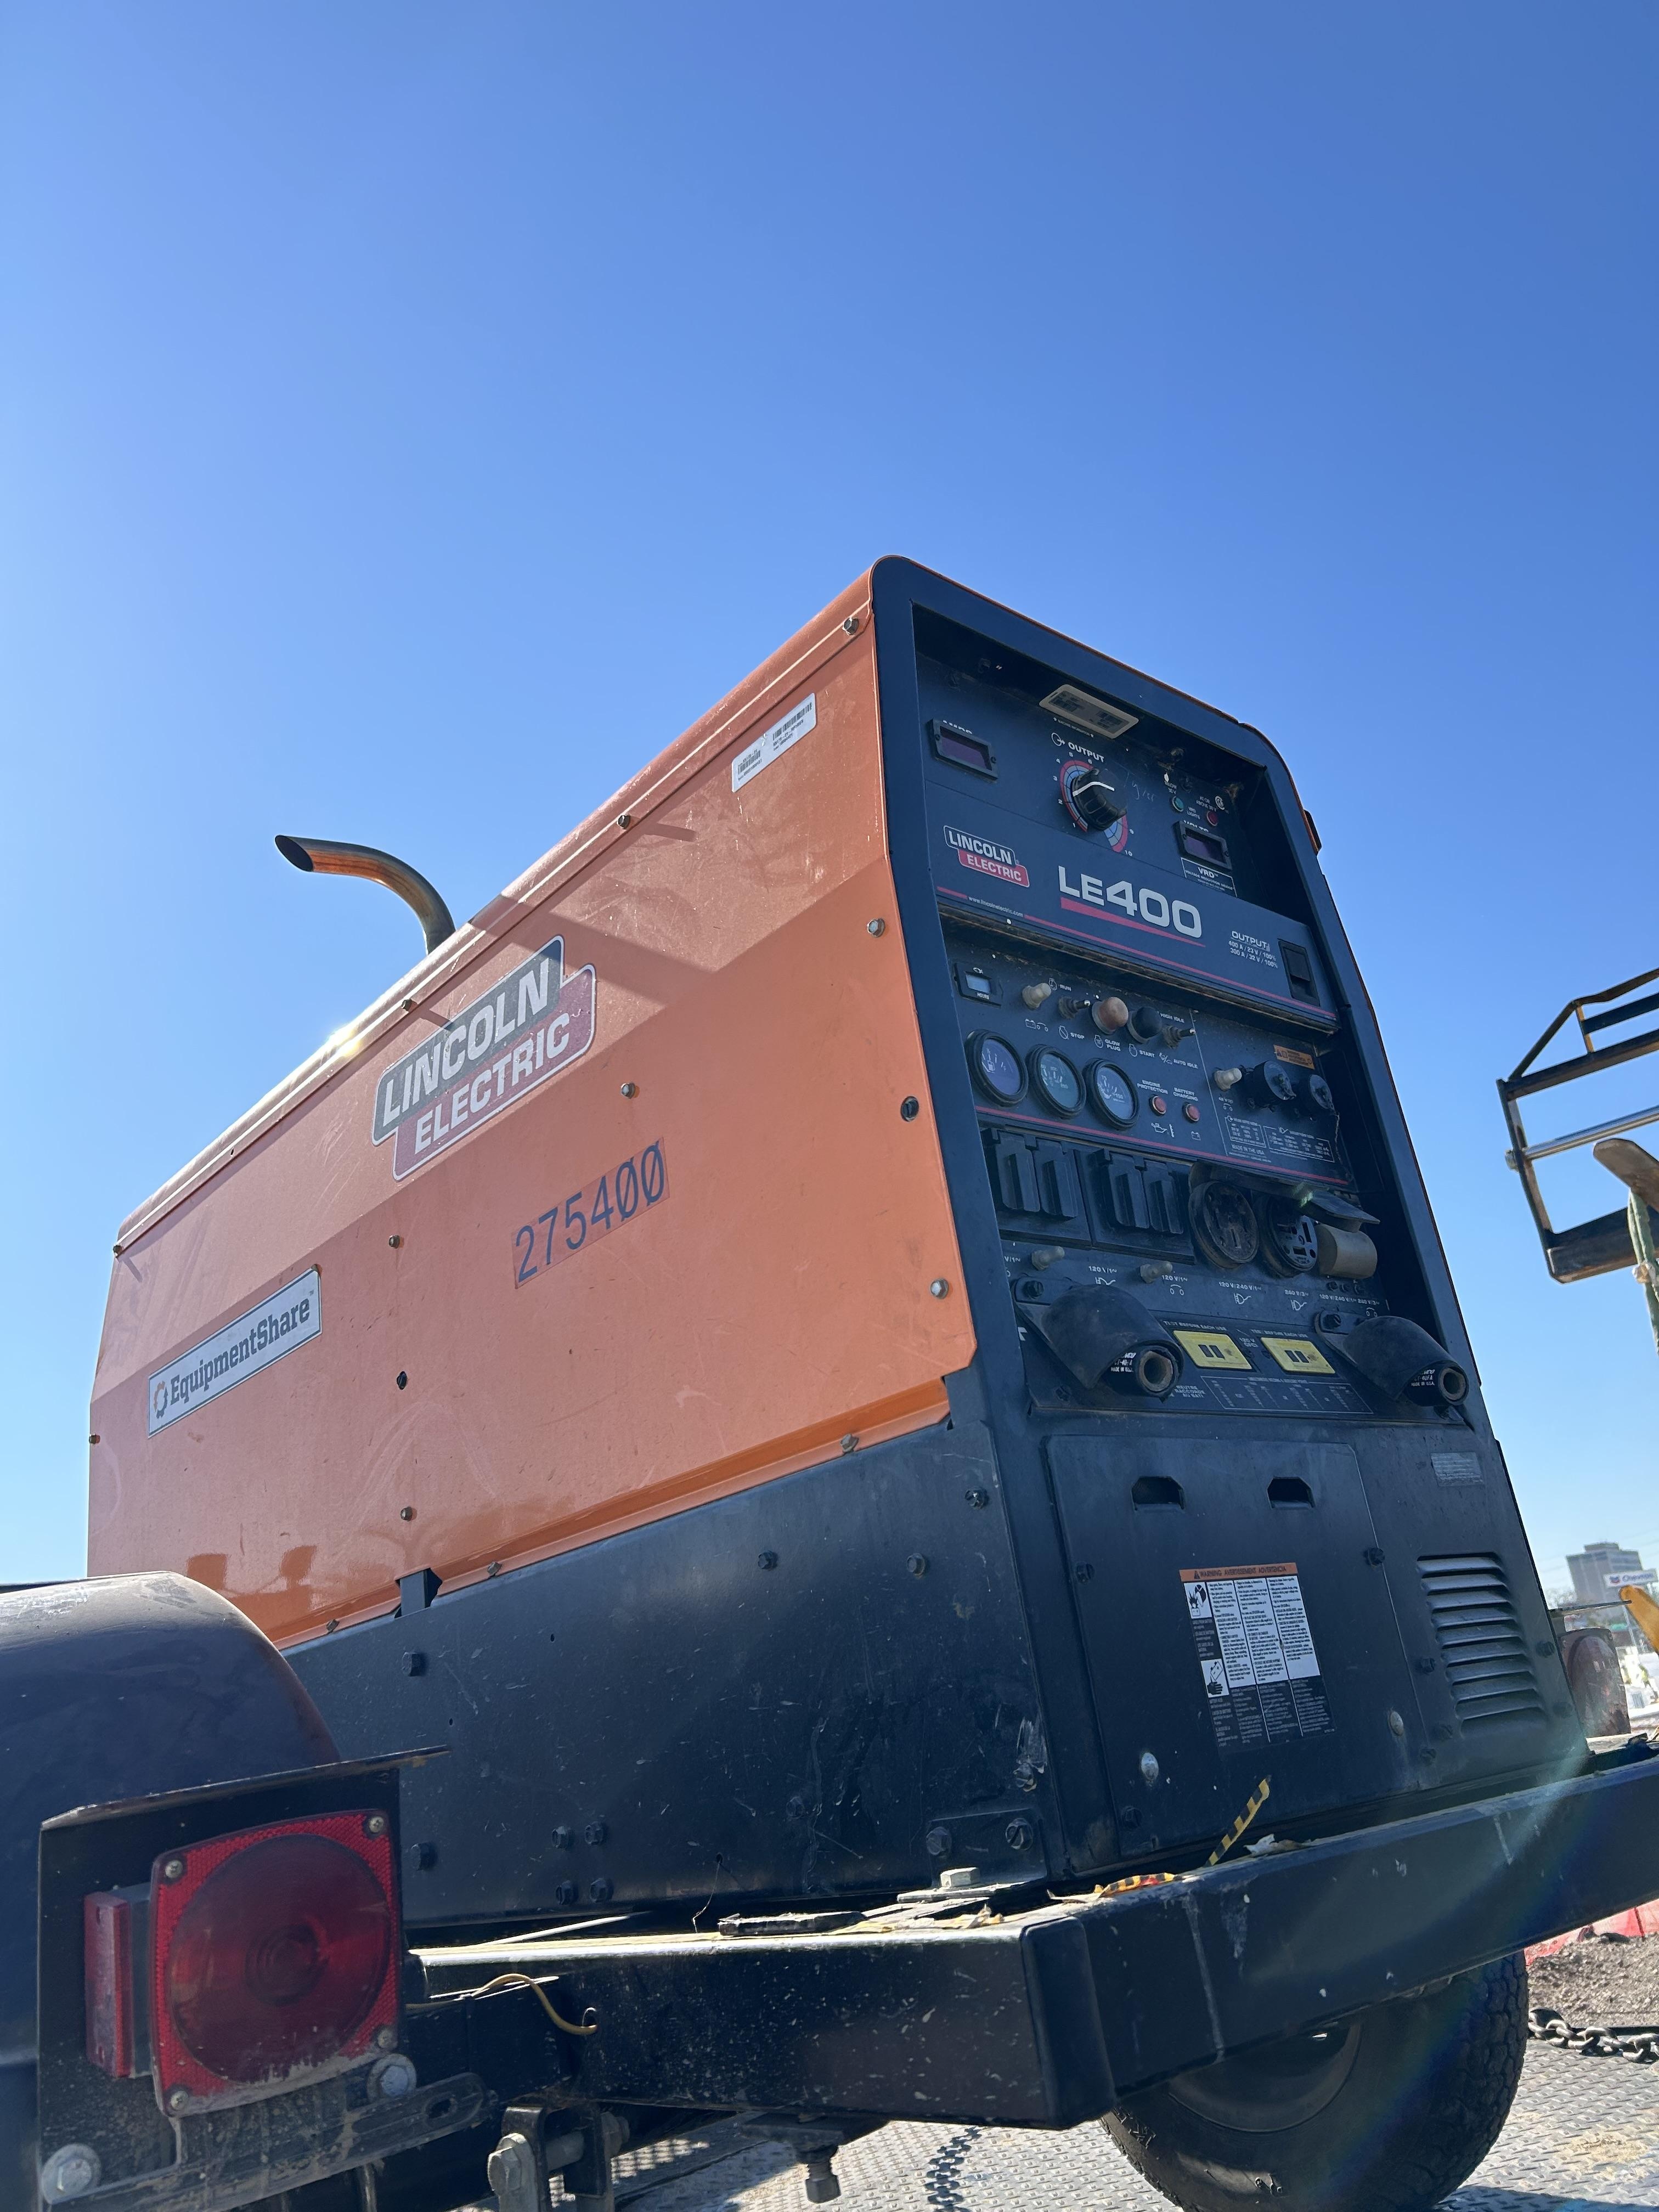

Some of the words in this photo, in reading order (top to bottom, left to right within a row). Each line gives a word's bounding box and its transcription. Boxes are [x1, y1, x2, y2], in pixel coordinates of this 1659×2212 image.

[1068, 742, 1104, 763] OUTPUT
[949, 830, 1012, 865] LINCOLN
[967, 854, 1022, 882] ELECTRIC
[968, 896, 1024, 918] www.lincolnelectric.com
[1058, 865, 1202, 938] LE400
[1232, 930, 1267, 949] OUTPUT
[383, 958, 550, 1127] LINCOLN
[1104, 1039, 1120, 1047] GLOW
[1139, 1049, 1155, 1058] START
[414, 1012, 571, 1154] ELECTRIC
[1137, 1083, 1169, 1094] PROTECTION
[1142, 1079, 1161, 1088] ENGINE
[1173, 1087, 1194, 1096] BATTERY
[1173, 1091, 1198, 1102] CHARGING
[516, 1140, 665, 1283] 275400
[170, 1298, 310, 1406] EquipmentShare
[1200, 1569, 1222, 1577] WARNING
